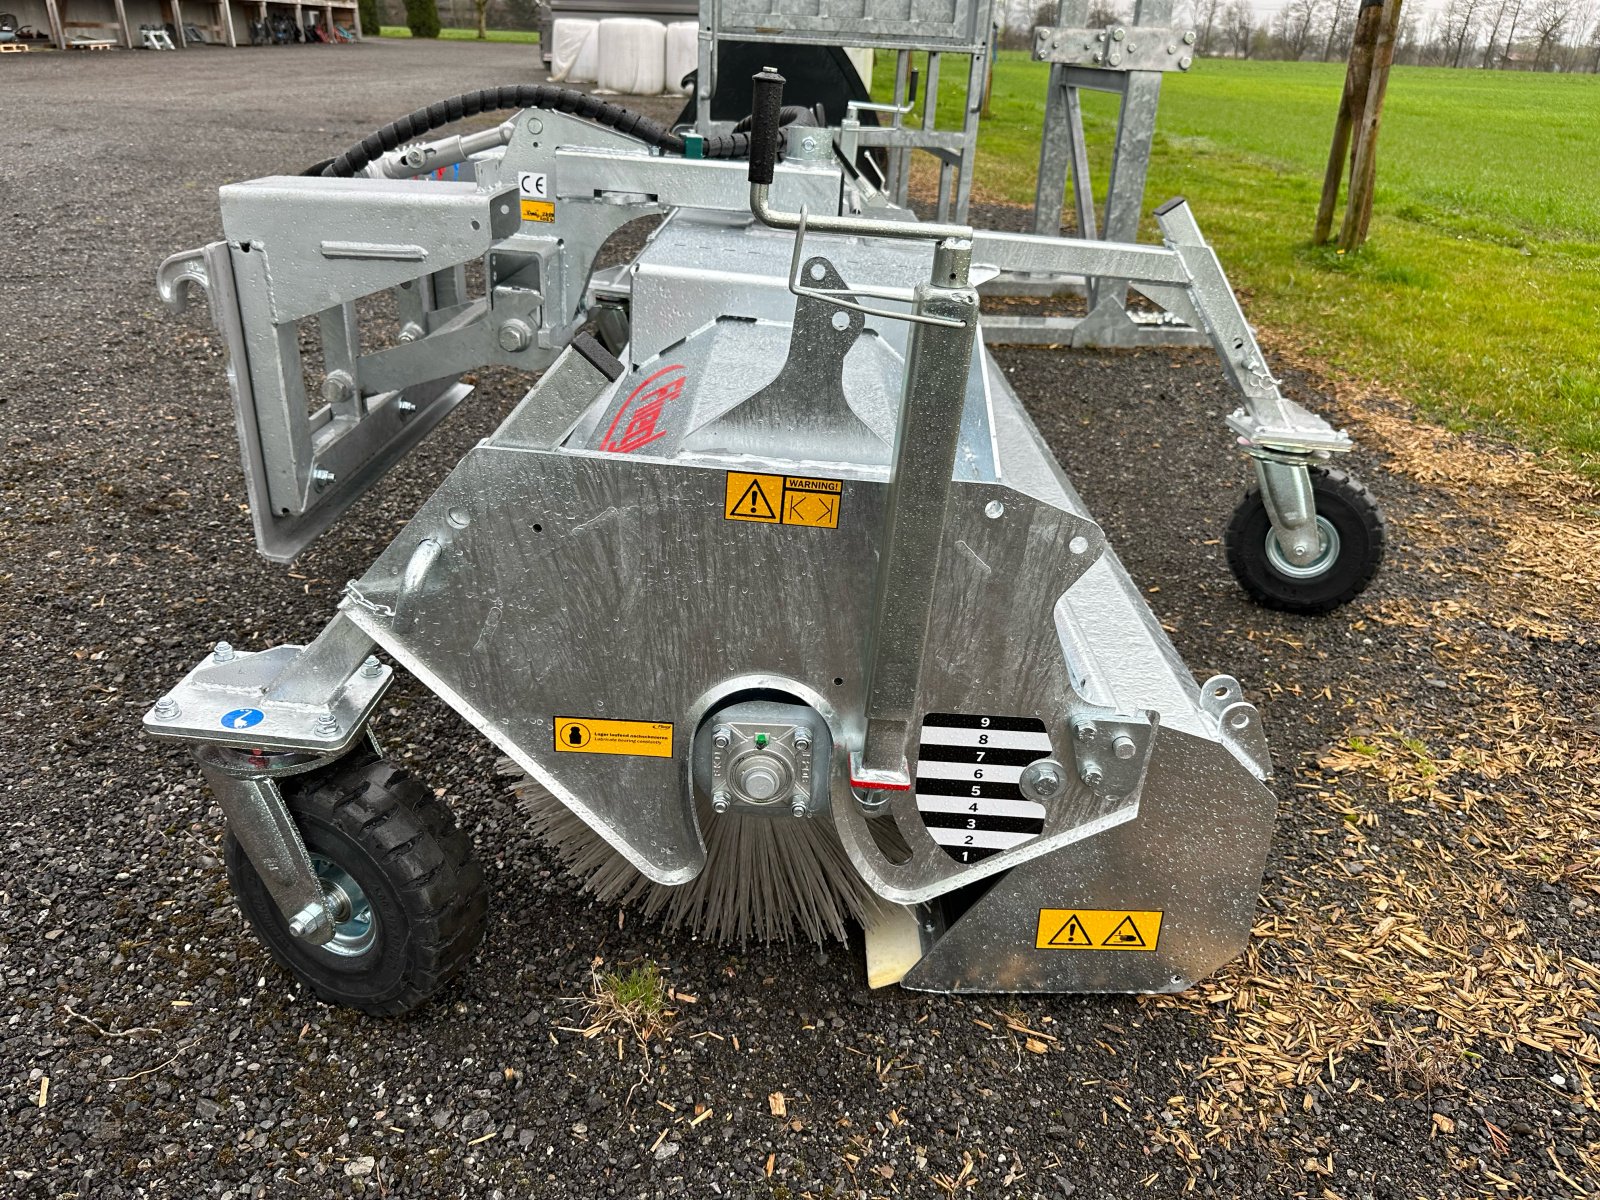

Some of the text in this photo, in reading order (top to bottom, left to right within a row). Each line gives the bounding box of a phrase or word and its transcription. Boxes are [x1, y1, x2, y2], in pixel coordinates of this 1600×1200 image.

[521, 175, 544, 194] CE
[789, 479, 838, 491] WARNING!
[981, 717, 990, 727] 9
[978, 734, 988, 744] 8
[976, 752, 986, 762] 7
[973, 769, 983, 779] 6
[971, 785, 981, 796] 5
[968, 803, 978, 812] 4
[966, 819, 976, 829] 3
[964, 835, 974, 845] 2
[962, 851, 969, 861] 1
